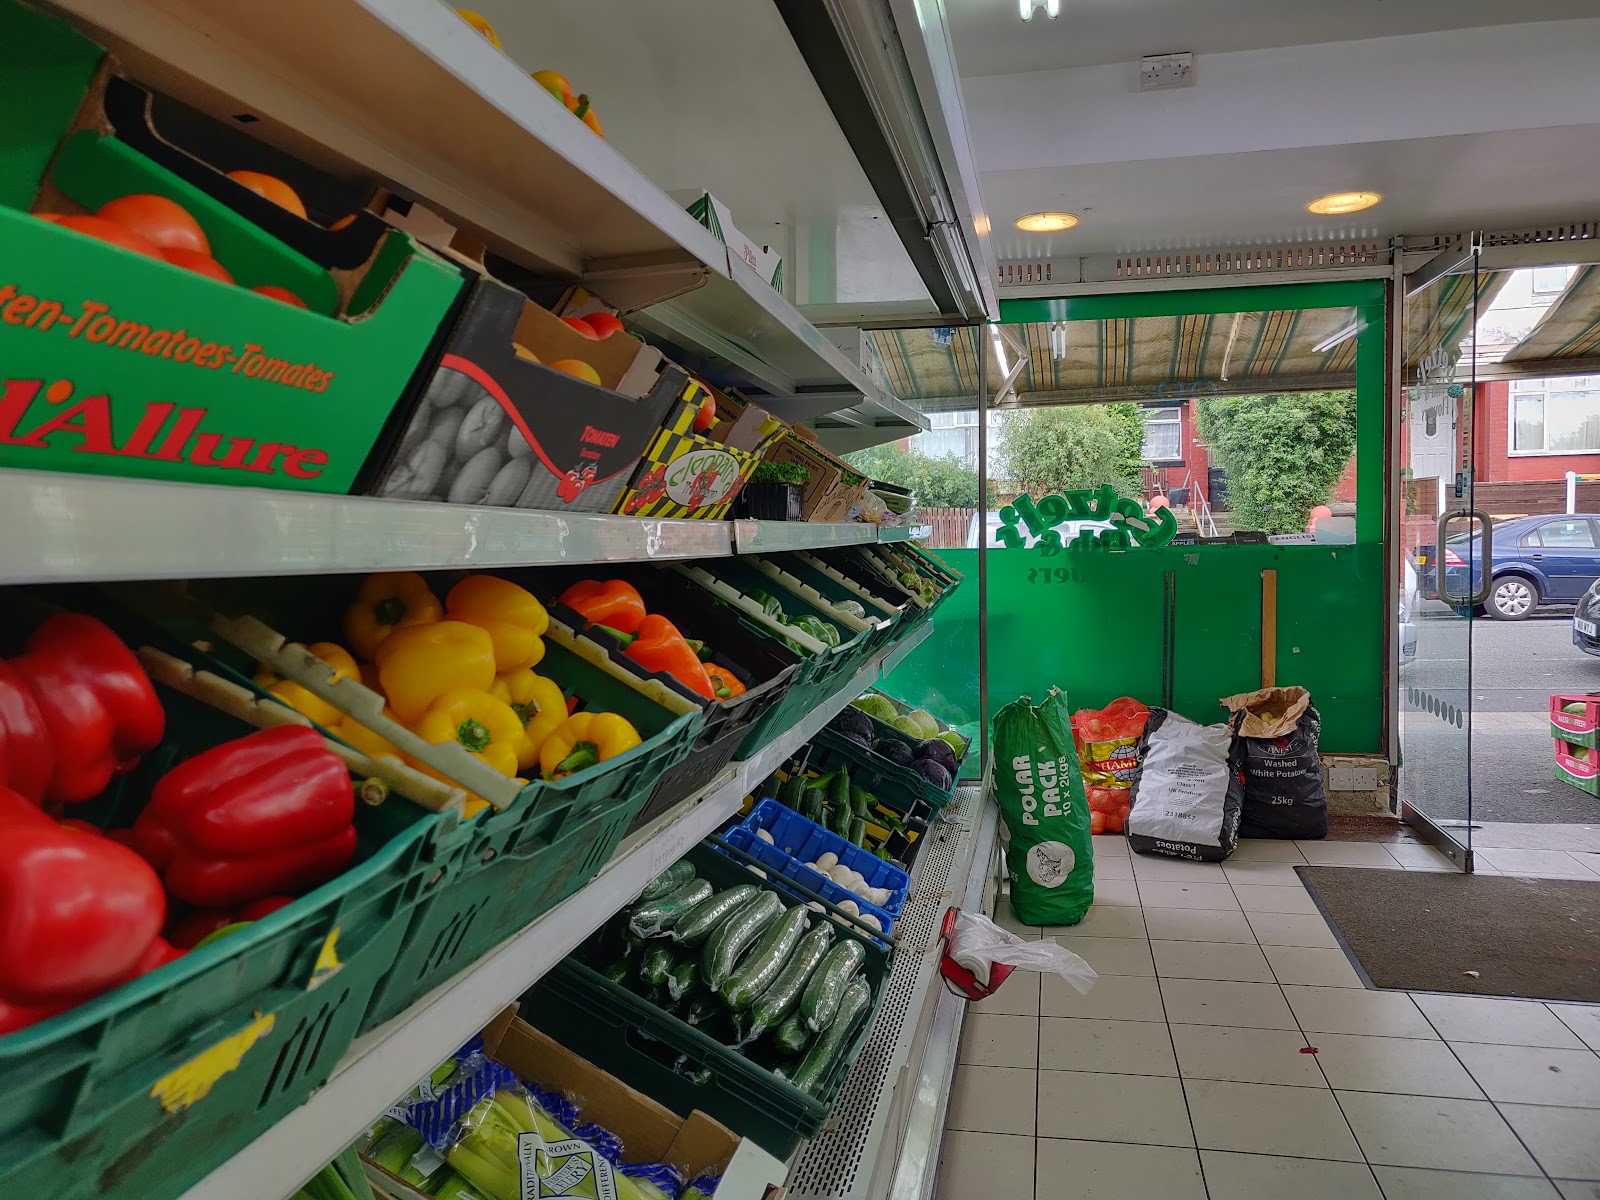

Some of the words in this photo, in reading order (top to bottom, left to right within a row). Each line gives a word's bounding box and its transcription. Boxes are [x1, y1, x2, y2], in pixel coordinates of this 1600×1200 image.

[1264, 759, 1297, 768] Washed
[1250, 769, 1275, 778] White
[1276, 768, 1307, 778] Potatoes
[1012, 754, 1040, 826] POLAR
[1037, 760, 1063, 818] PACK
[1271, 796, 1294, 806] 25kg
[1061, 801, 1072, 817] 10
[1156, 840, 1197, 855] Potatoes
[551, 1161, 589, 1192] CELERY
